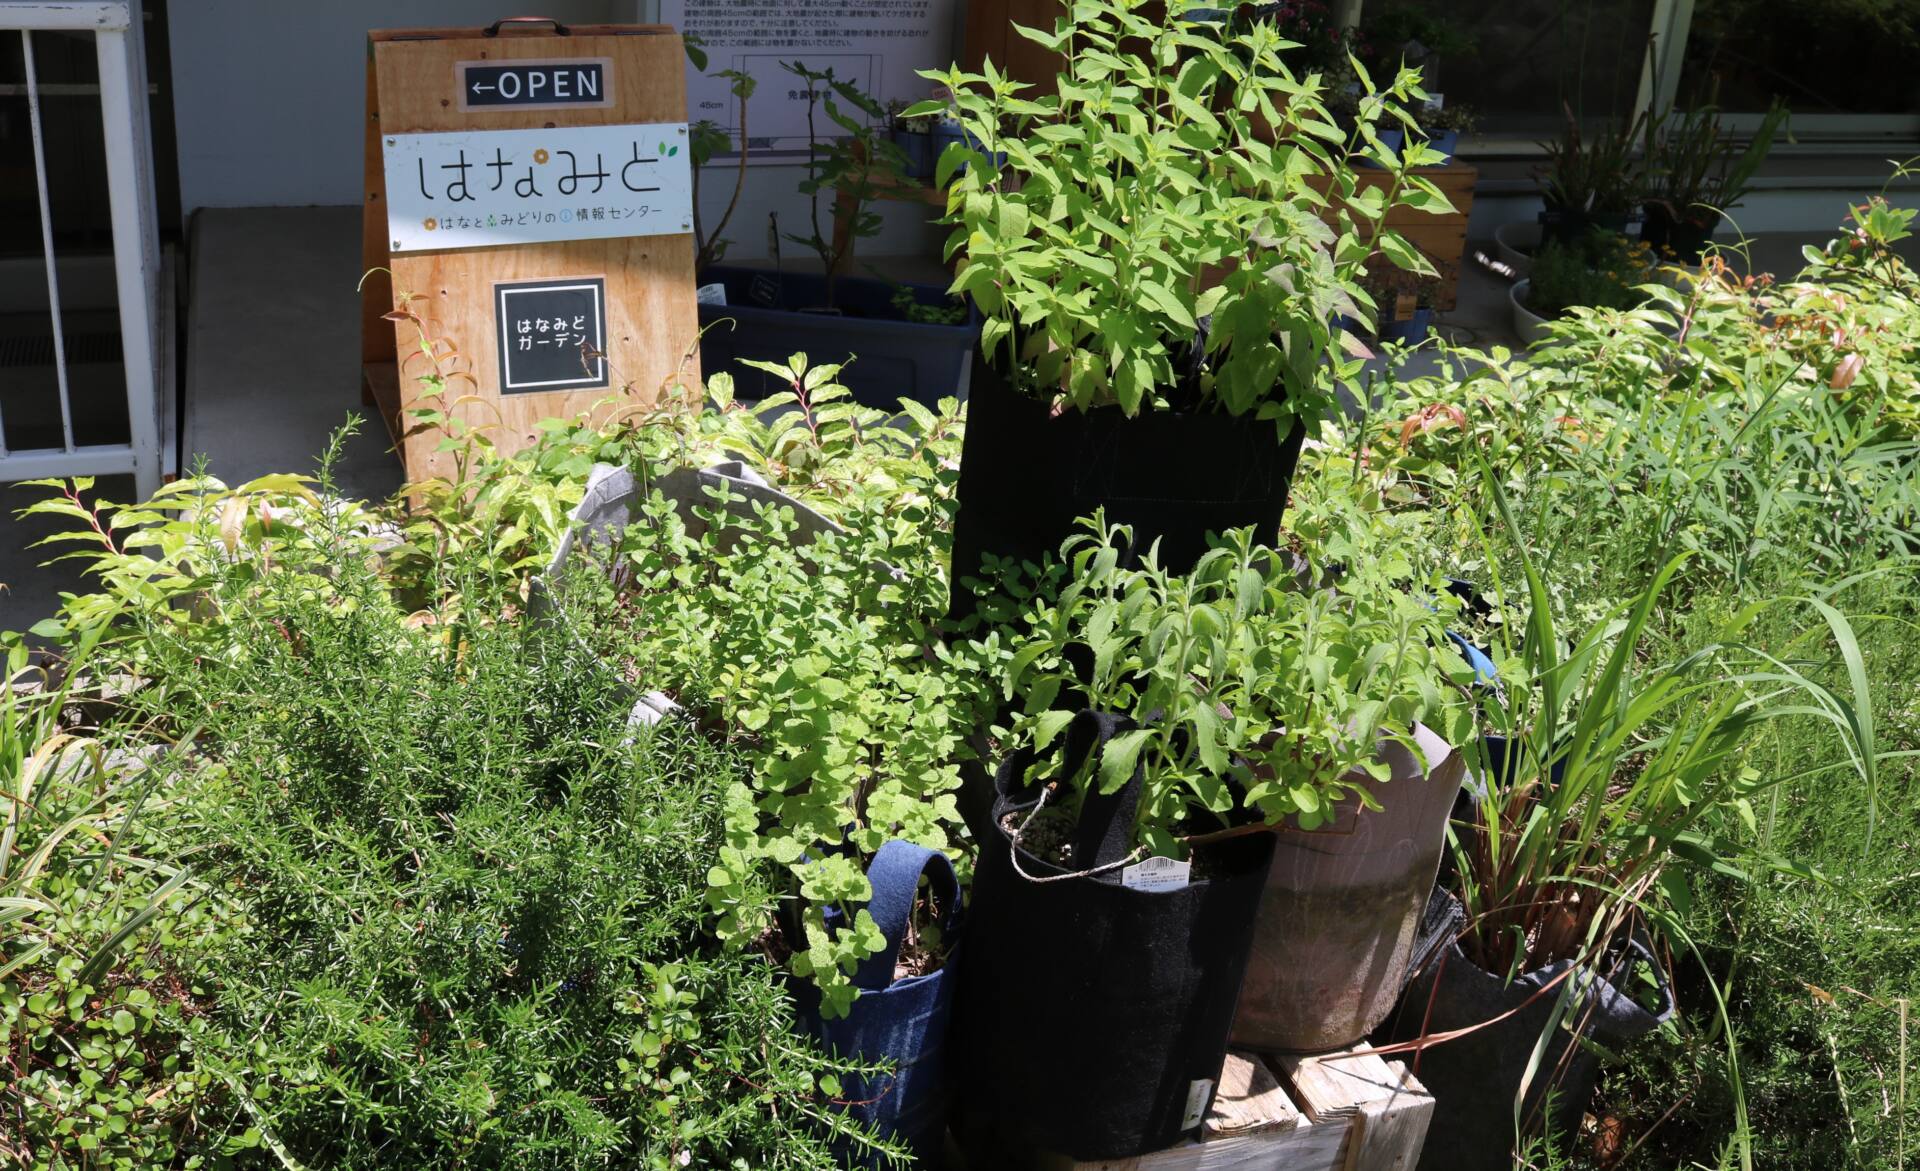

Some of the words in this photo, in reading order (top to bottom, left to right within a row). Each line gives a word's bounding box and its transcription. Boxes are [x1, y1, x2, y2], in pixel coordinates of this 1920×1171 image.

[498, 70, 597, 99] OPEN
[699, 101, 724, 110] 45cm
[517, 315, 585, 334] はなみど
[518, 332, 586, 351] ガーデン
